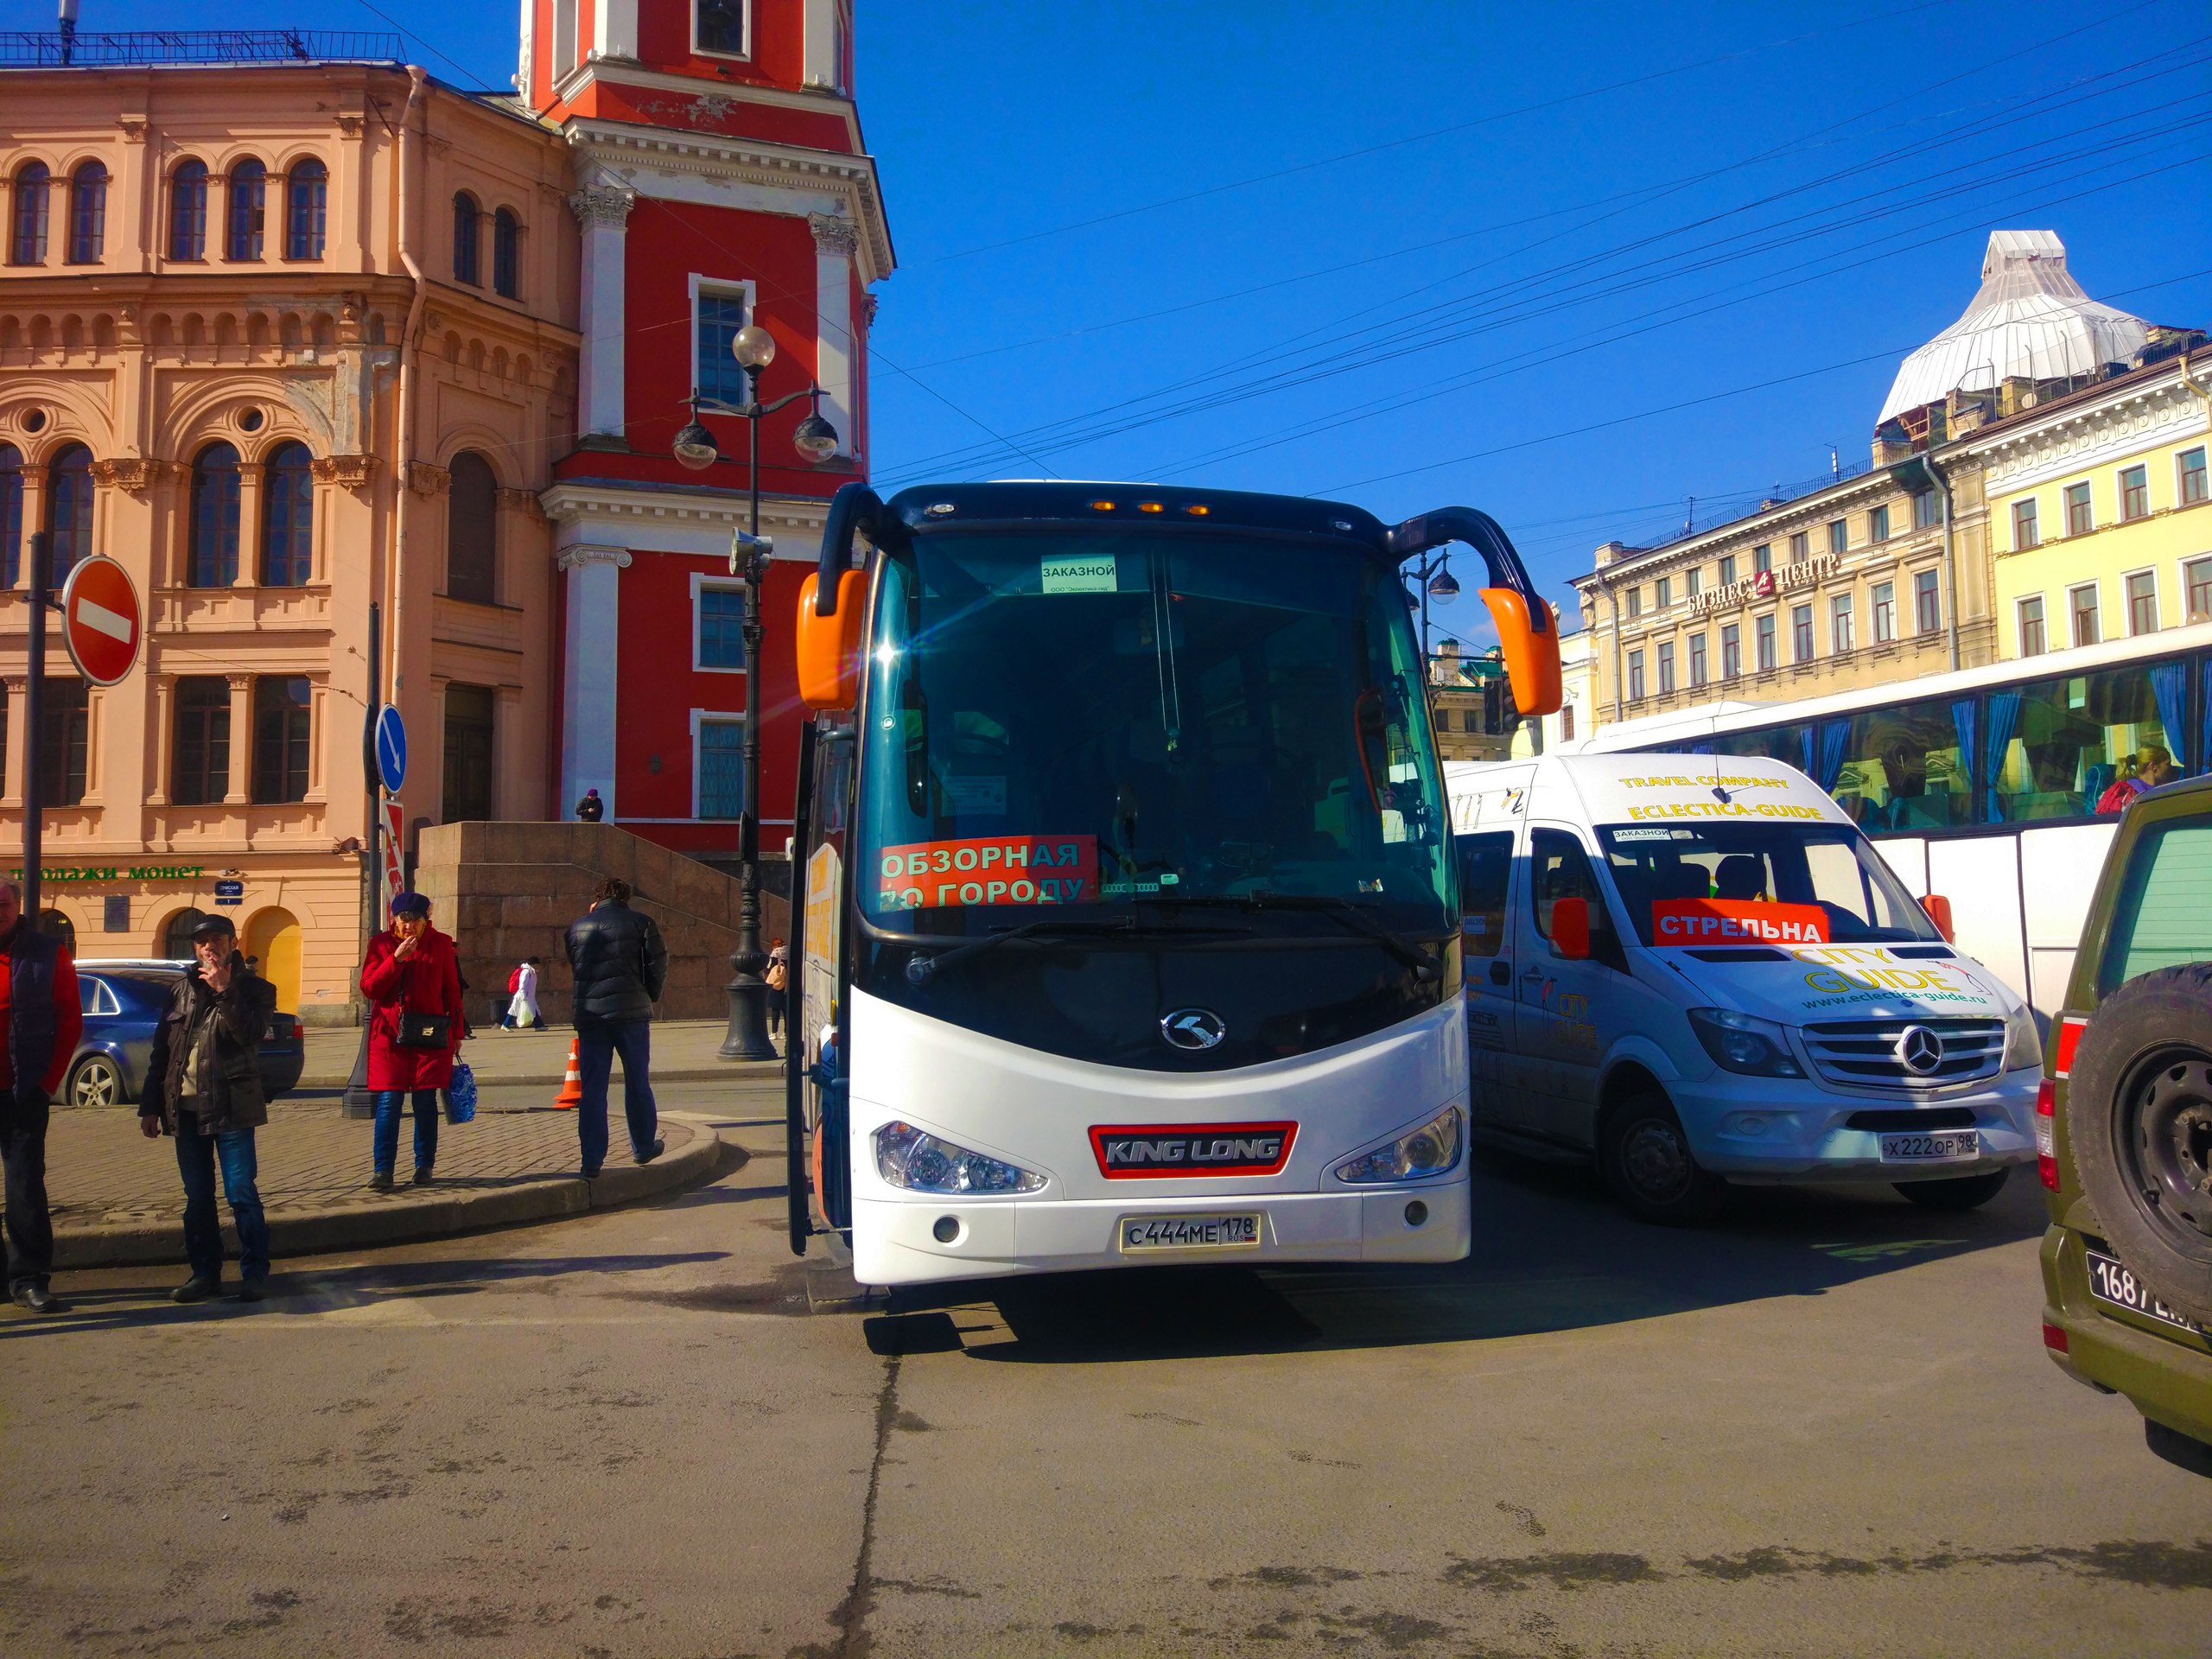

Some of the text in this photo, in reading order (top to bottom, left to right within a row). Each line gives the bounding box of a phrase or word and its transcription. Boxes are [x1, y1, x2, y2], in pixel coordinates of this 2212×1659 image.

[1043, 564, 1115, 577] ЗАКАЗНОЙ
[1686, 553, 1839, 613] БИЗНЕС ЦЕНТР
[1618, 775, 1789, 790] TRAVEL COMPANY
[1627, 803, 1826, 821] ECLECTICA-GUIDE
[880, 843, 1079, 879] ОБЗОРНАЯ
[10, 866, 204, 882] подажи монет
[938, 878, 1085, 907] ГОРОДУ
[1660, 915, 1822, 944] СТРЕЛЬНА
[1790, 948, 1893, 965] CITY
[1804, 969, 1961, 993] GUIDE
[1801, 990, 1988, 1009] www.eclectica-guide.ru
[1106, 1138, 1281, 1163] KING LONG
[1958, 1135, 1972, 1148] 98
[1128, 1217, 1254, 1245] С444МЕ 178
